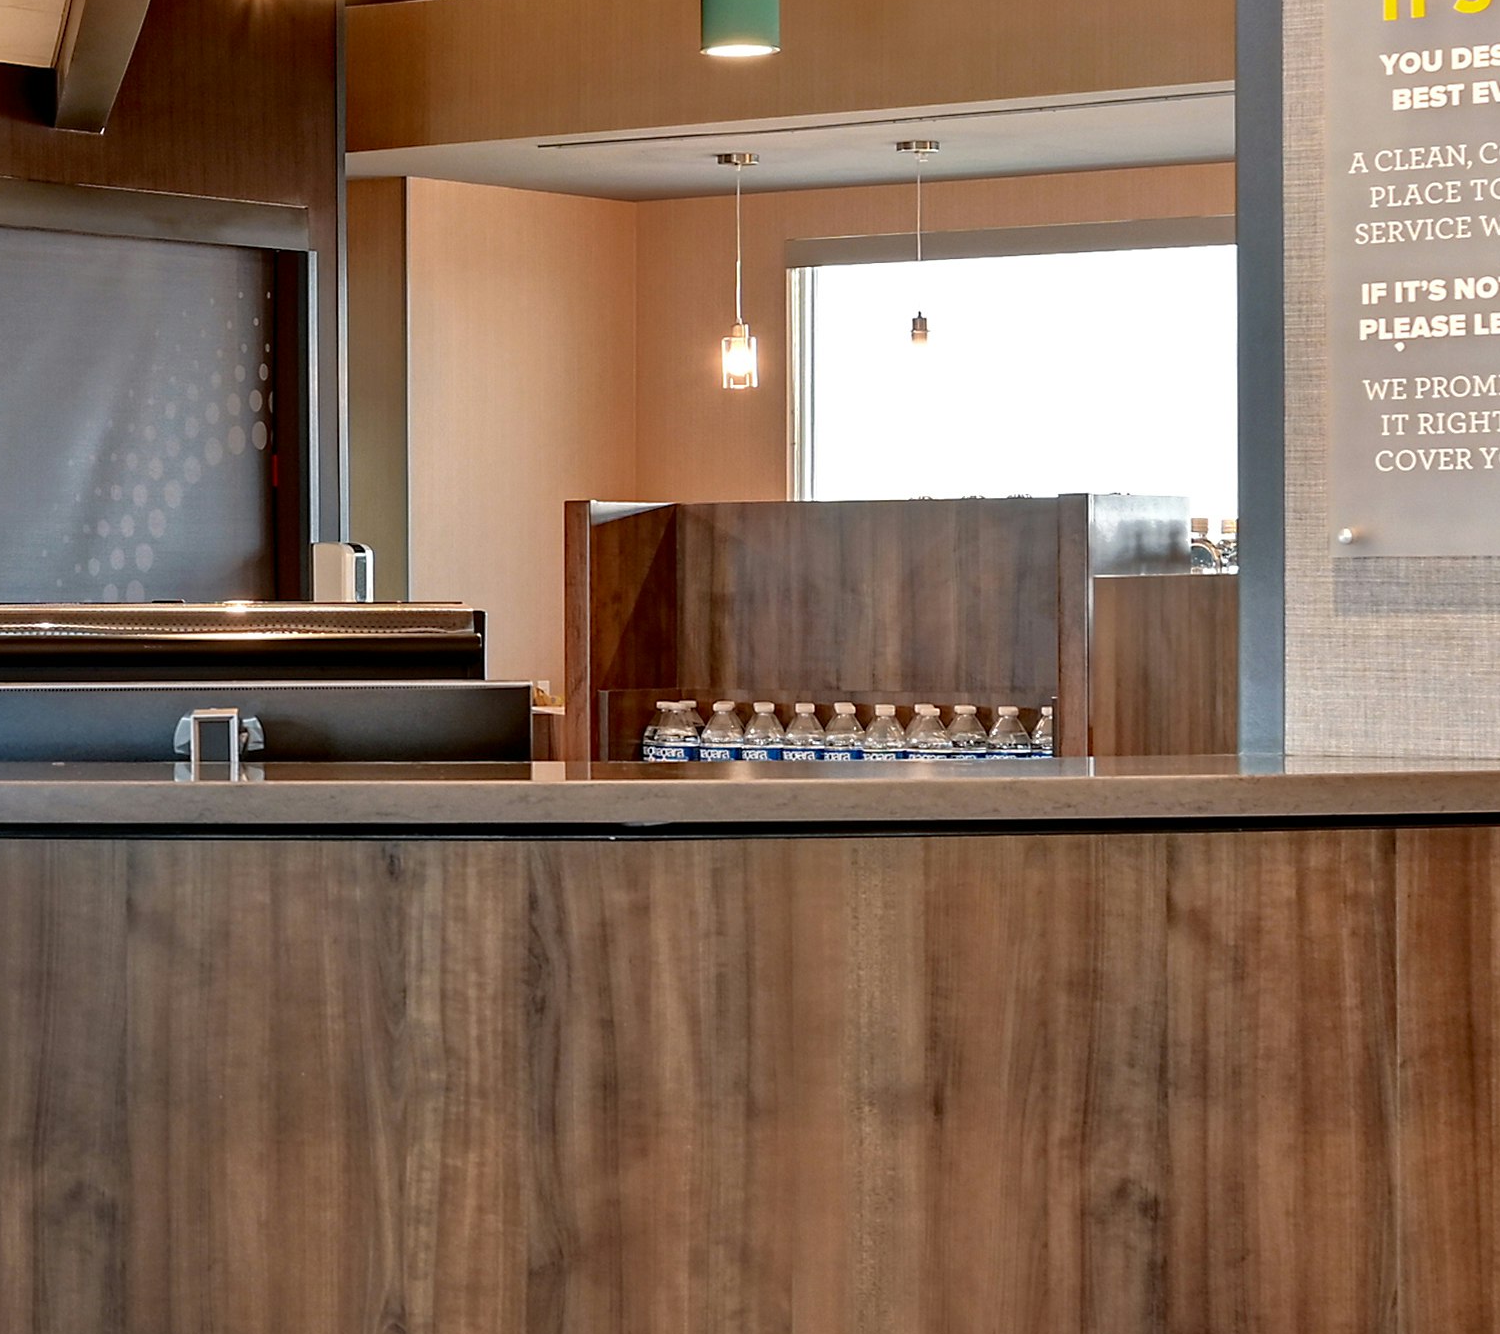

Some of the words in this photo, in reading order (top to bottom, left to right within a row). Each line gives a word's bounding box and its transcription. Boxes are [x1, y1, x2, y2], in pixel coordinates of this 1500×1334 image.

[1378, 49, 1443, 76] YOU
[1392, 83, 1465, 111] BEST
[1348, 152, 1369, 174] A
[1374, 144, 1473, 172] CLEAN,
[1369, 180, 1462, 208] PLACE
[1354, 216, 1472, 245] SERVICE
[1361, 282, 1387, 305] IF
[1394, 279, 1447, 303] IT'S
[1359, 314, 1466, 341] PLEASE
[1362, 378, 1407, 401] WE
[1380, 414, 1409, 436] IT
[1375, 448, 1474, 472] COVER
